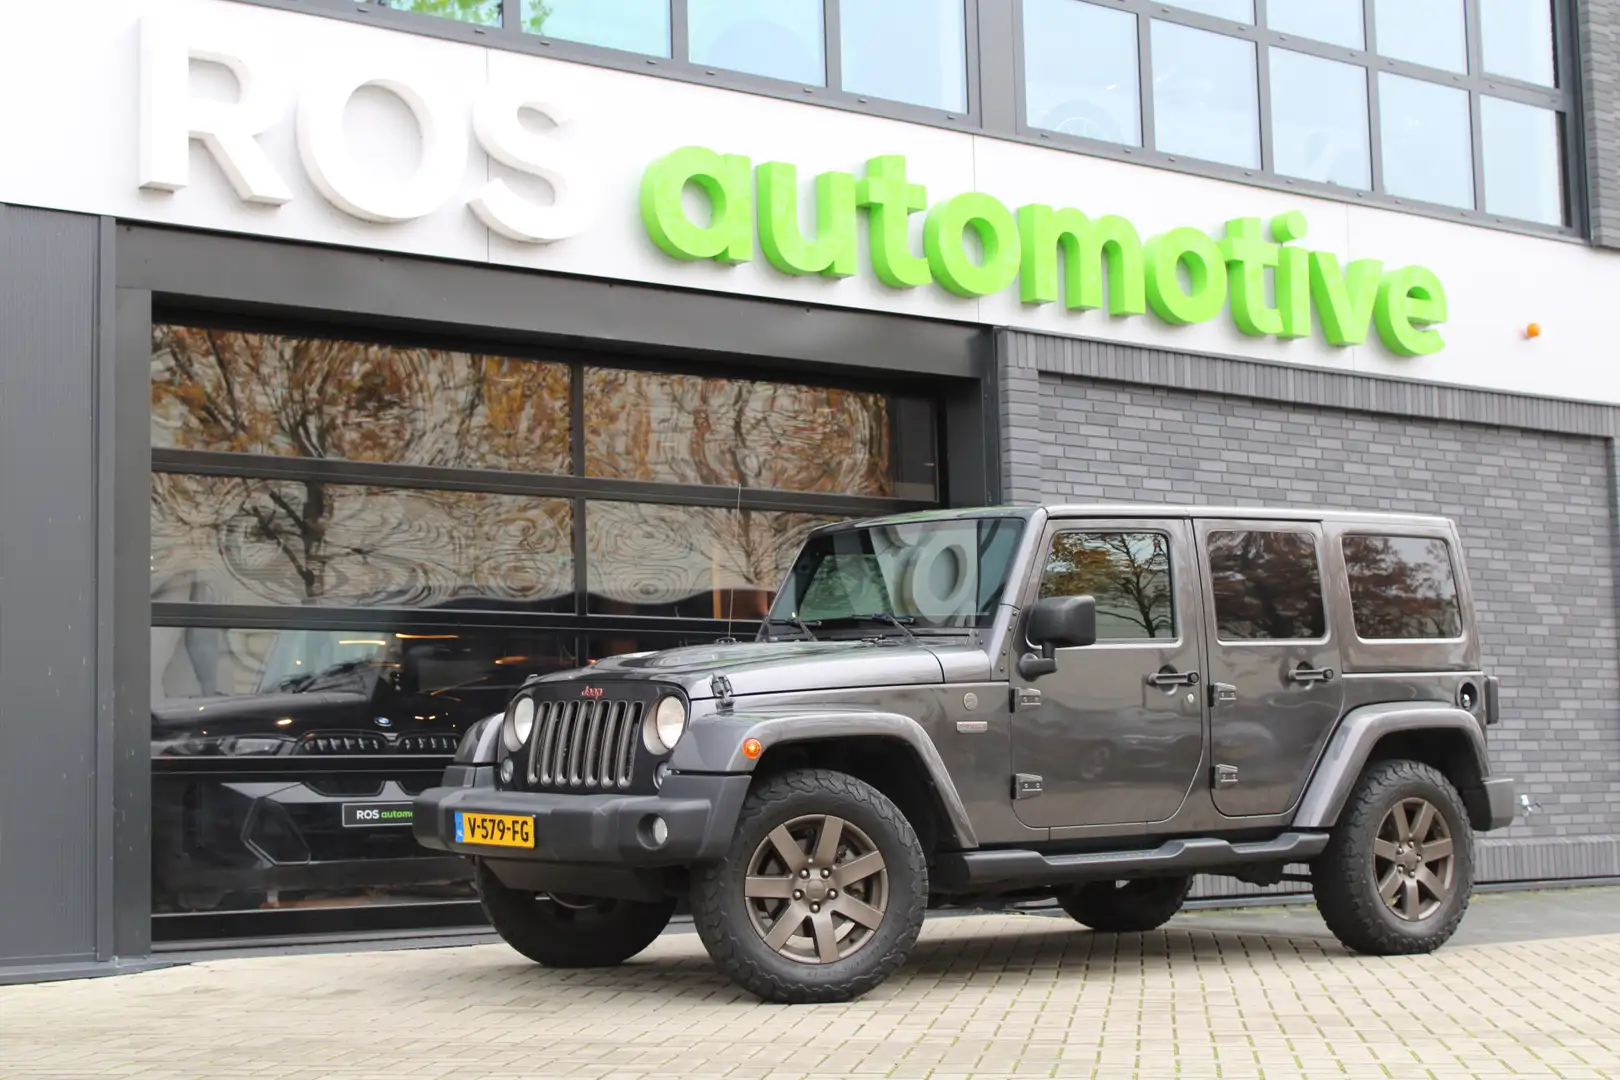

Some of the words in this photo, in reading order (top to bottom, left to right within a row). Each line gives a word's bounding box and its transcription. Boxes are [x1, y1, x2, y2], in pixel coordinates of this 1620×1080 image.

[138, 17, 600, 243] ROS
[640, 146, 1447, 357] automotive
[356, 809, 380, 820] ROS
[467, 817, 529, 842] V-579-FG
